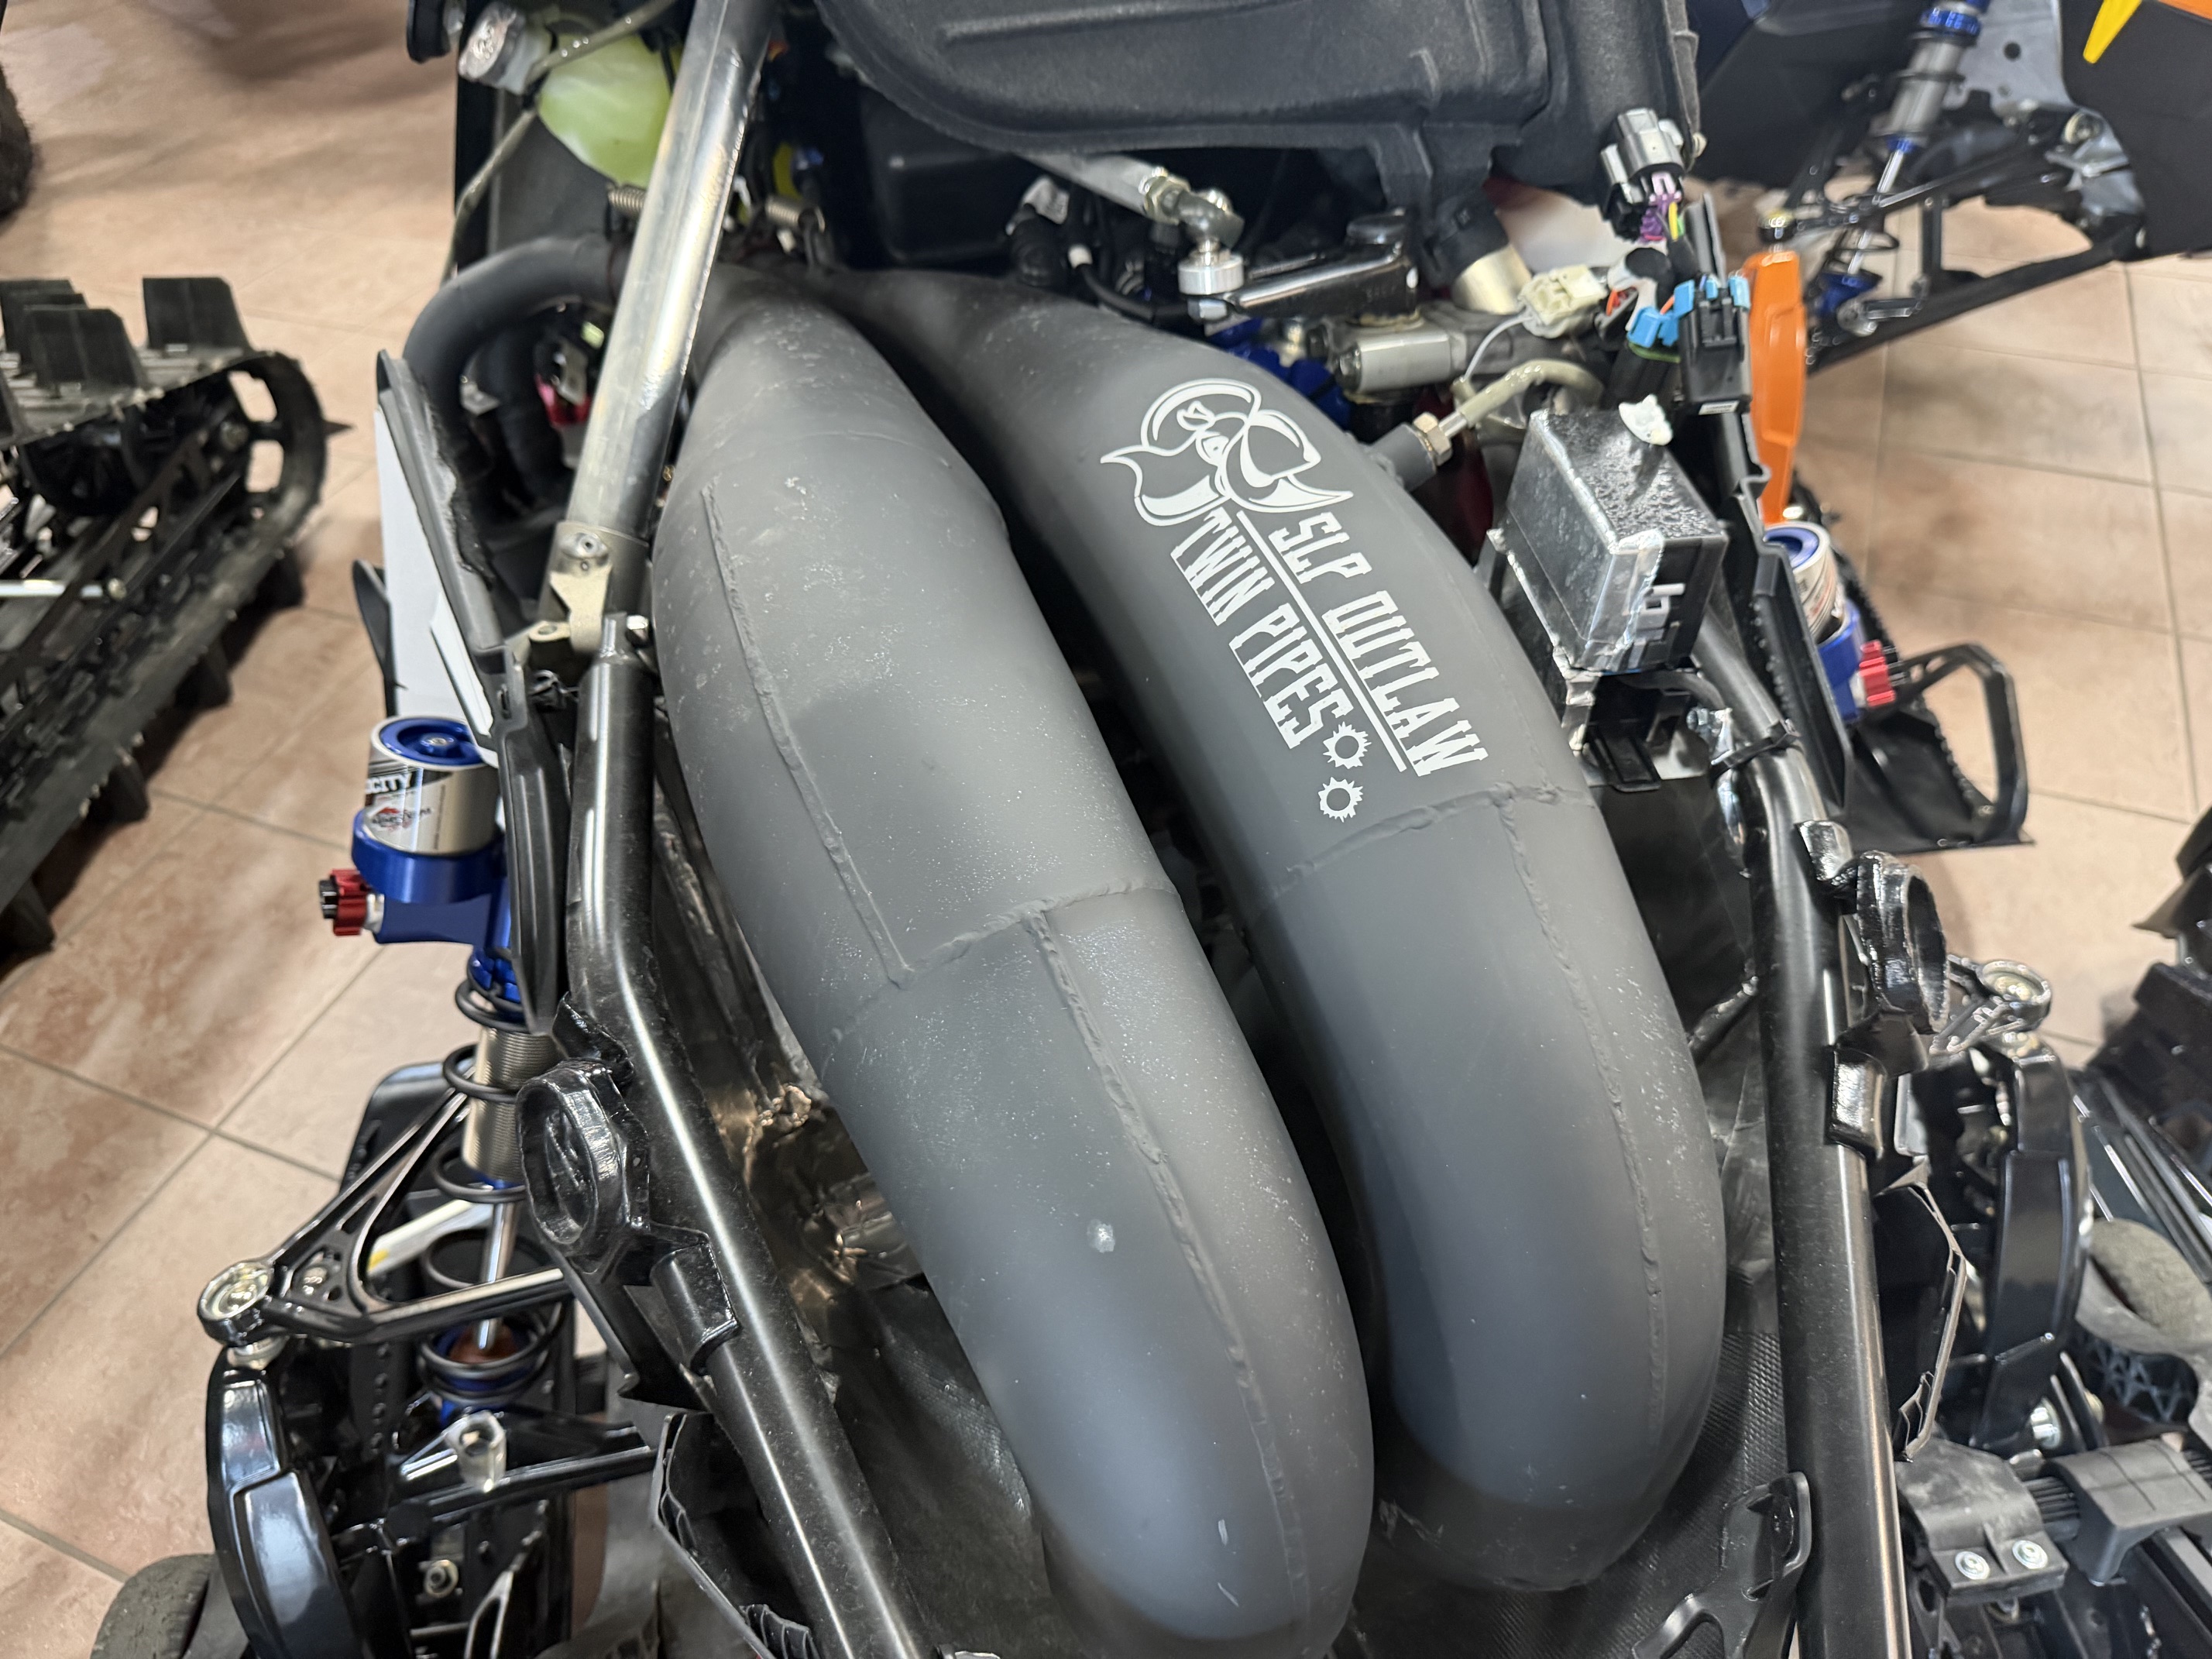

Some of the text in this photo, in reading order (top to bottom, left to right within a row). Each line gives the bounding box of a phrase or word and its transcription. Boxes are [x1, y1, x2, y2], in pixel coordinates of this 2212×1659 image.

[1170, 507, 1354, 750] TWIN PIPES
[1268, 511, 1489, 777] SLP OUTLAW
